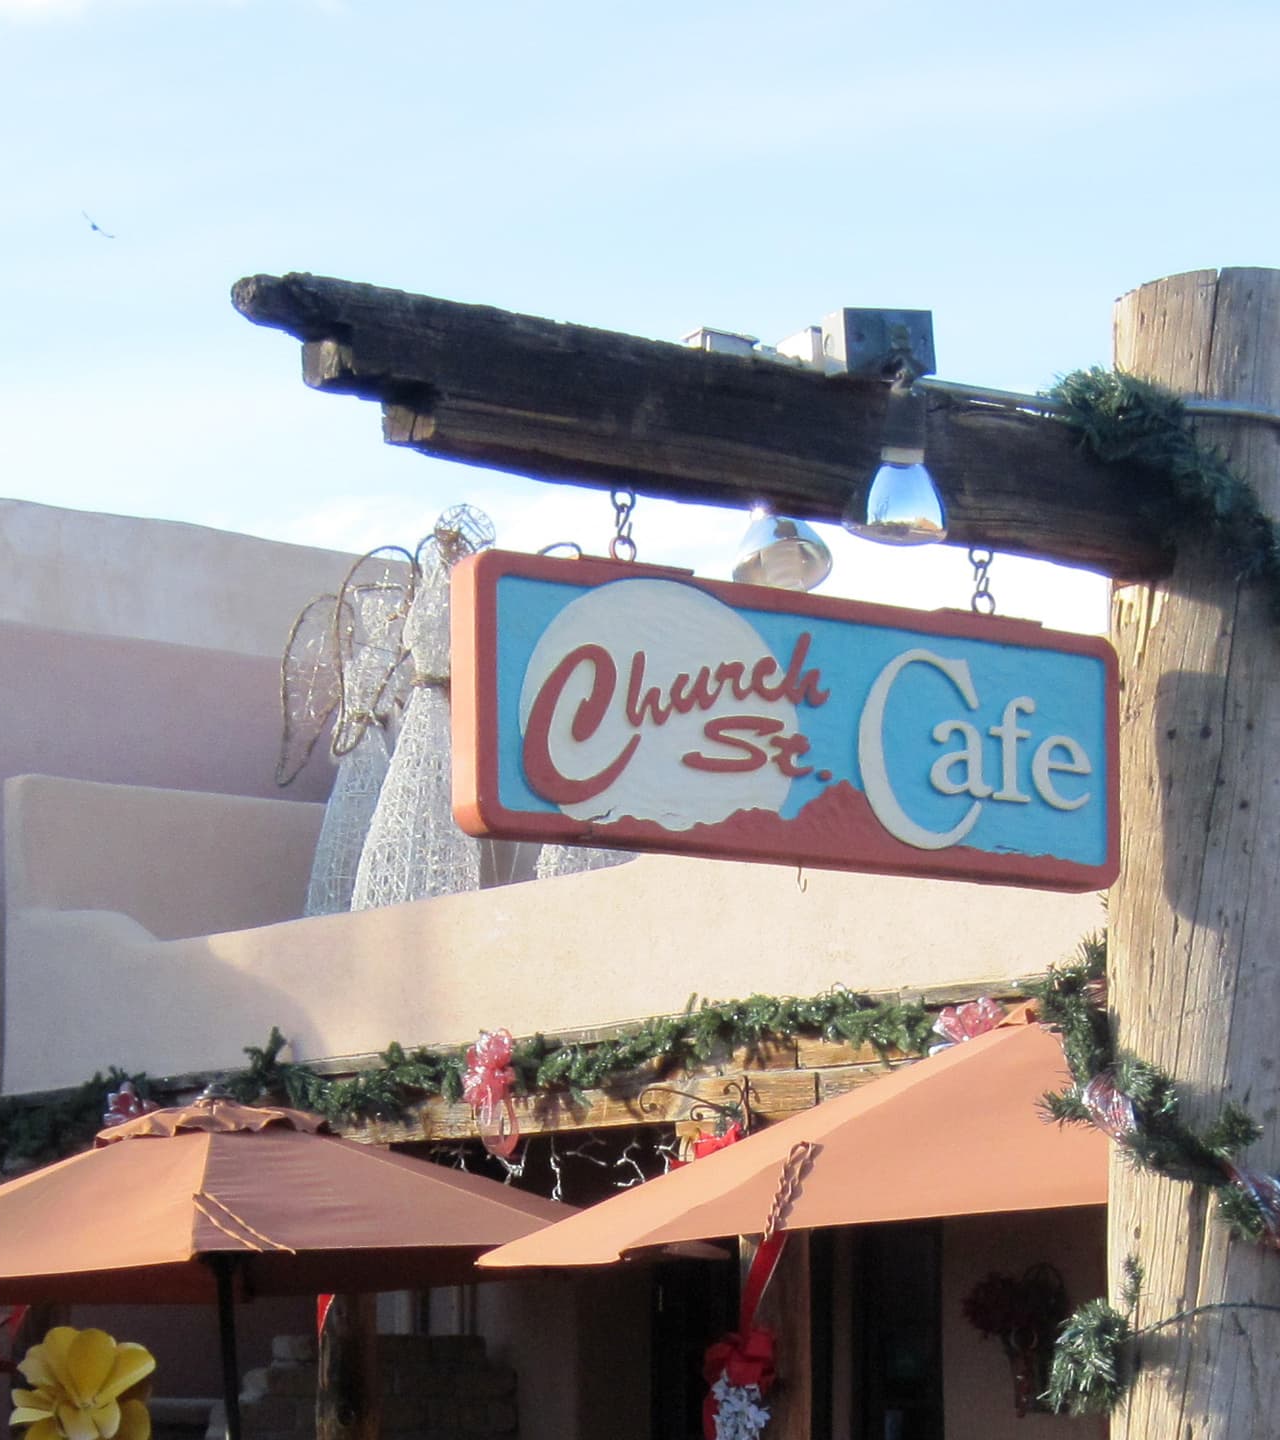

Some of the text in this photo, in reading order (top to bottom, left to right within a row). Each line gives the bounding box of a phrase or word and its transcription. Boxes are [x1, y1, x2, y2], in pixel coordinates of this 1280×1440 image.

[522, 632, 830, 805] Church
[681, 715, 833, 783] St.
[857, 648, 1092, 851] Cafe
